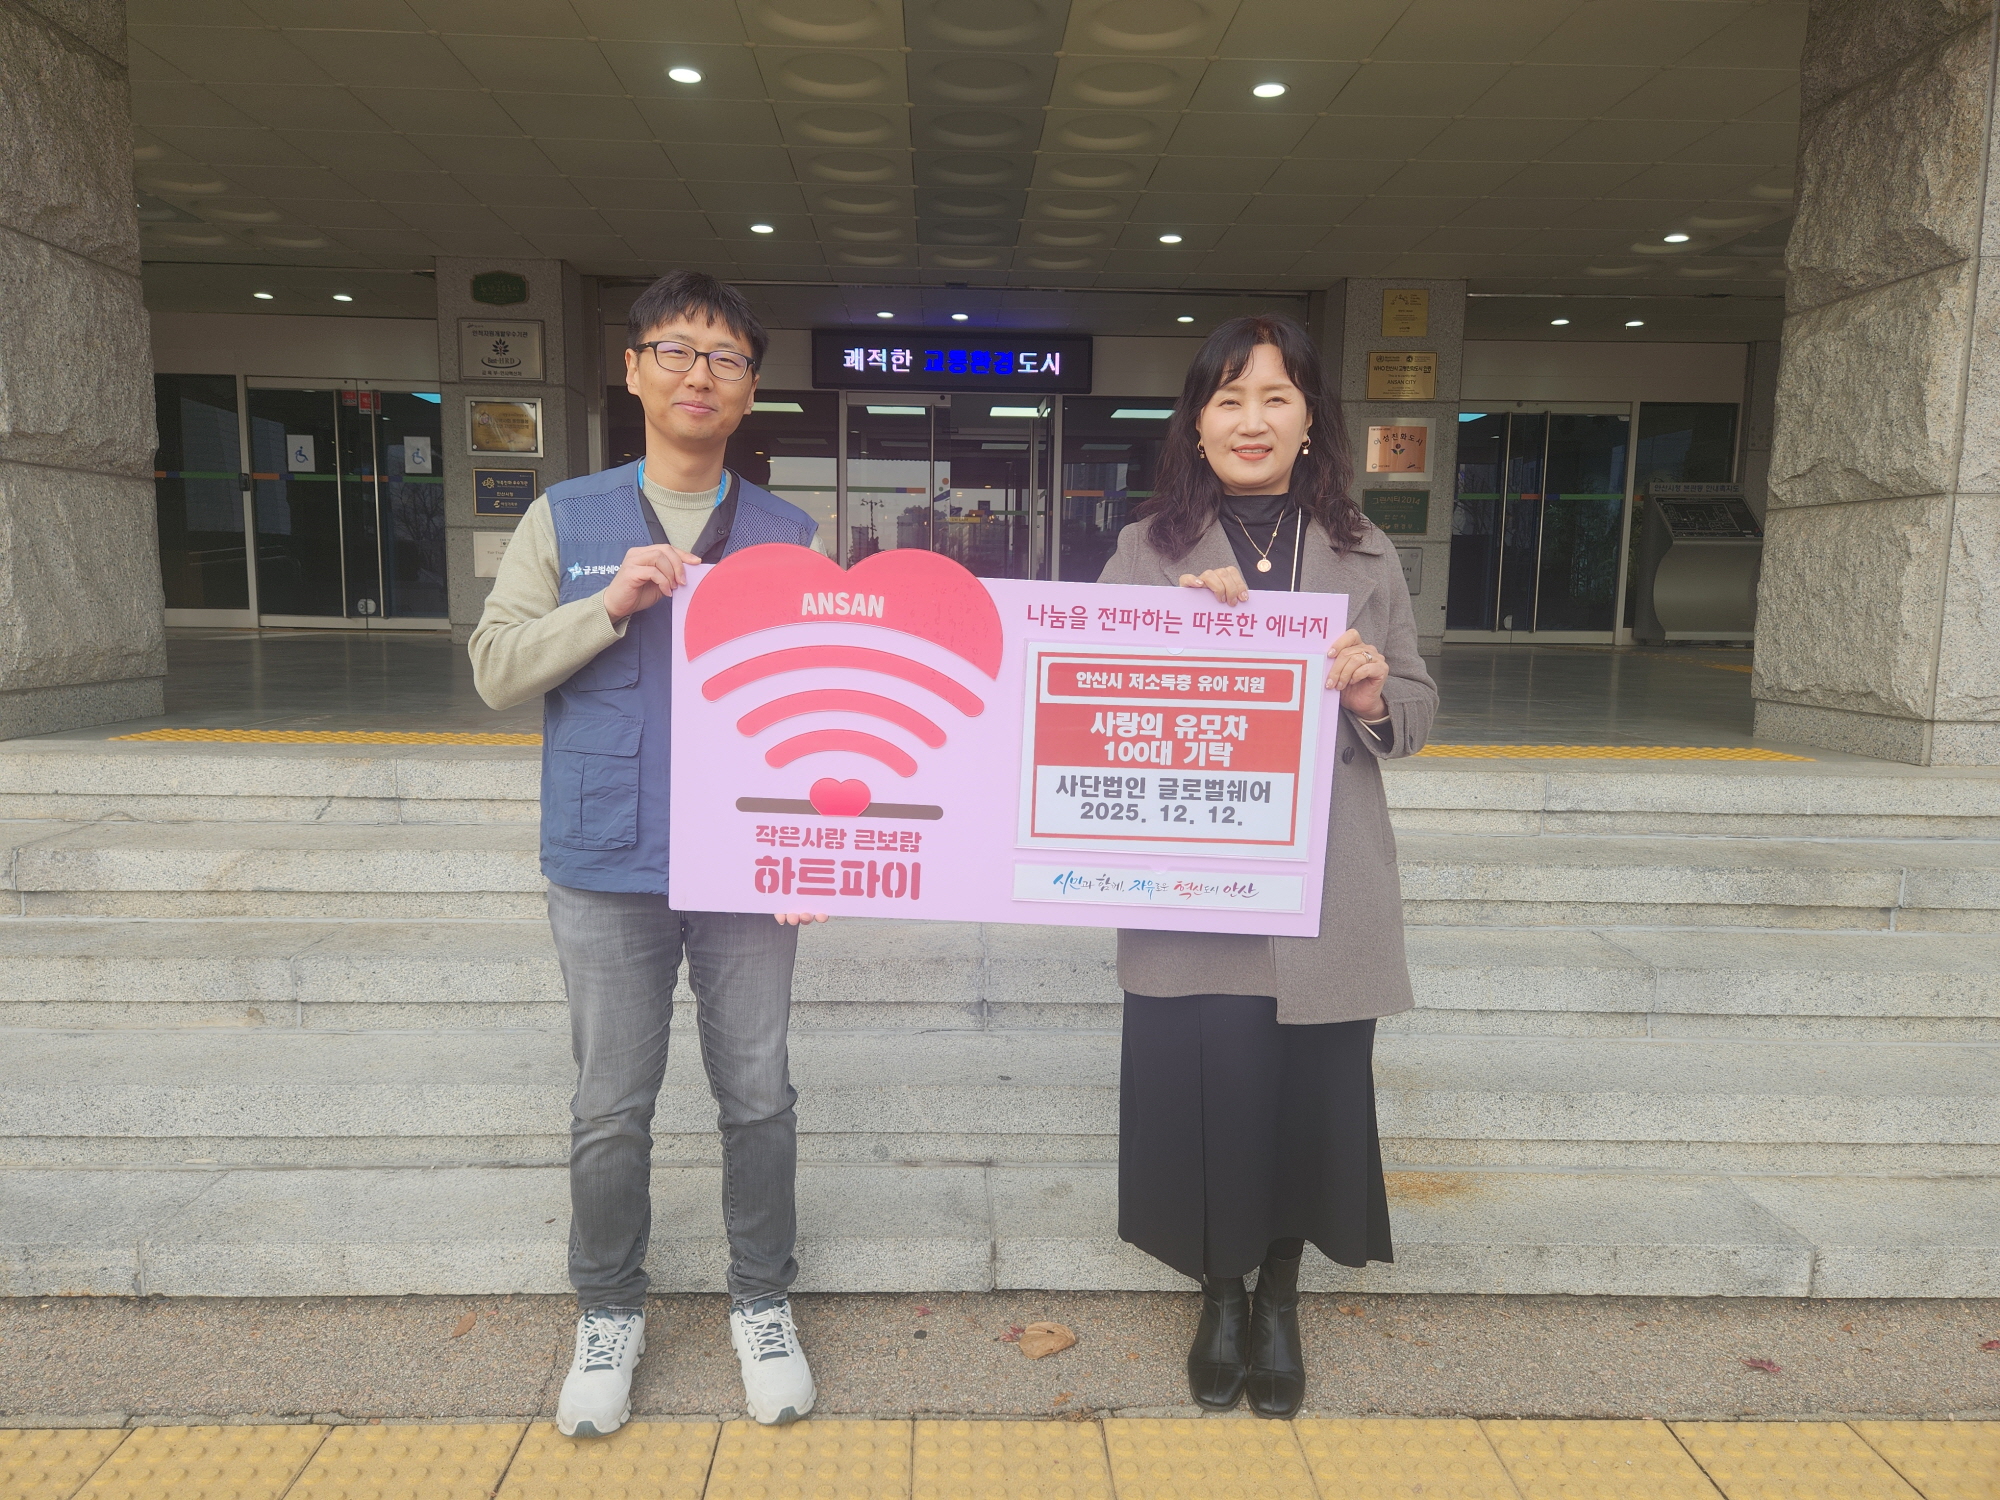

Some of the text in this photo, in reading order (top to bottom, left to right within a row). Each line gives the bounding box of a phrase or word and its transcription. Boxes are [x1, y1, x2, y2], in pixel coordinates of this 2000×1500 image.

[843, 347, 913, 373] 쾌적한
[1373, 432, 1424, 447] 여성친화도시
[1654, 484, 1681, 492] 안산시청
[801, 592, 885, 618] ANSAN
[1027, 604, 1329, 639] 나눔을 전파하는 따뜻한 에너지
[1076, 671, 1266, 694] 안산시 저소득층 유아 지원
[1090, 712, 1249, 741] 사랑의 유모차
[1103, 741, 1234, 767] 100대 기탁
[1055, 774, 1272, 803] 사단법인 글로벌쉐어
[1080, 802, 1243, 826] 2025. 12. 12.
[755, 824, 923, 853] 작은사랑 큰보람
[754, 855, 922, 900] 하트파이
[1052, 870, 1260, 900] 시민과 함께, 자유로운 혁신도시 안산
